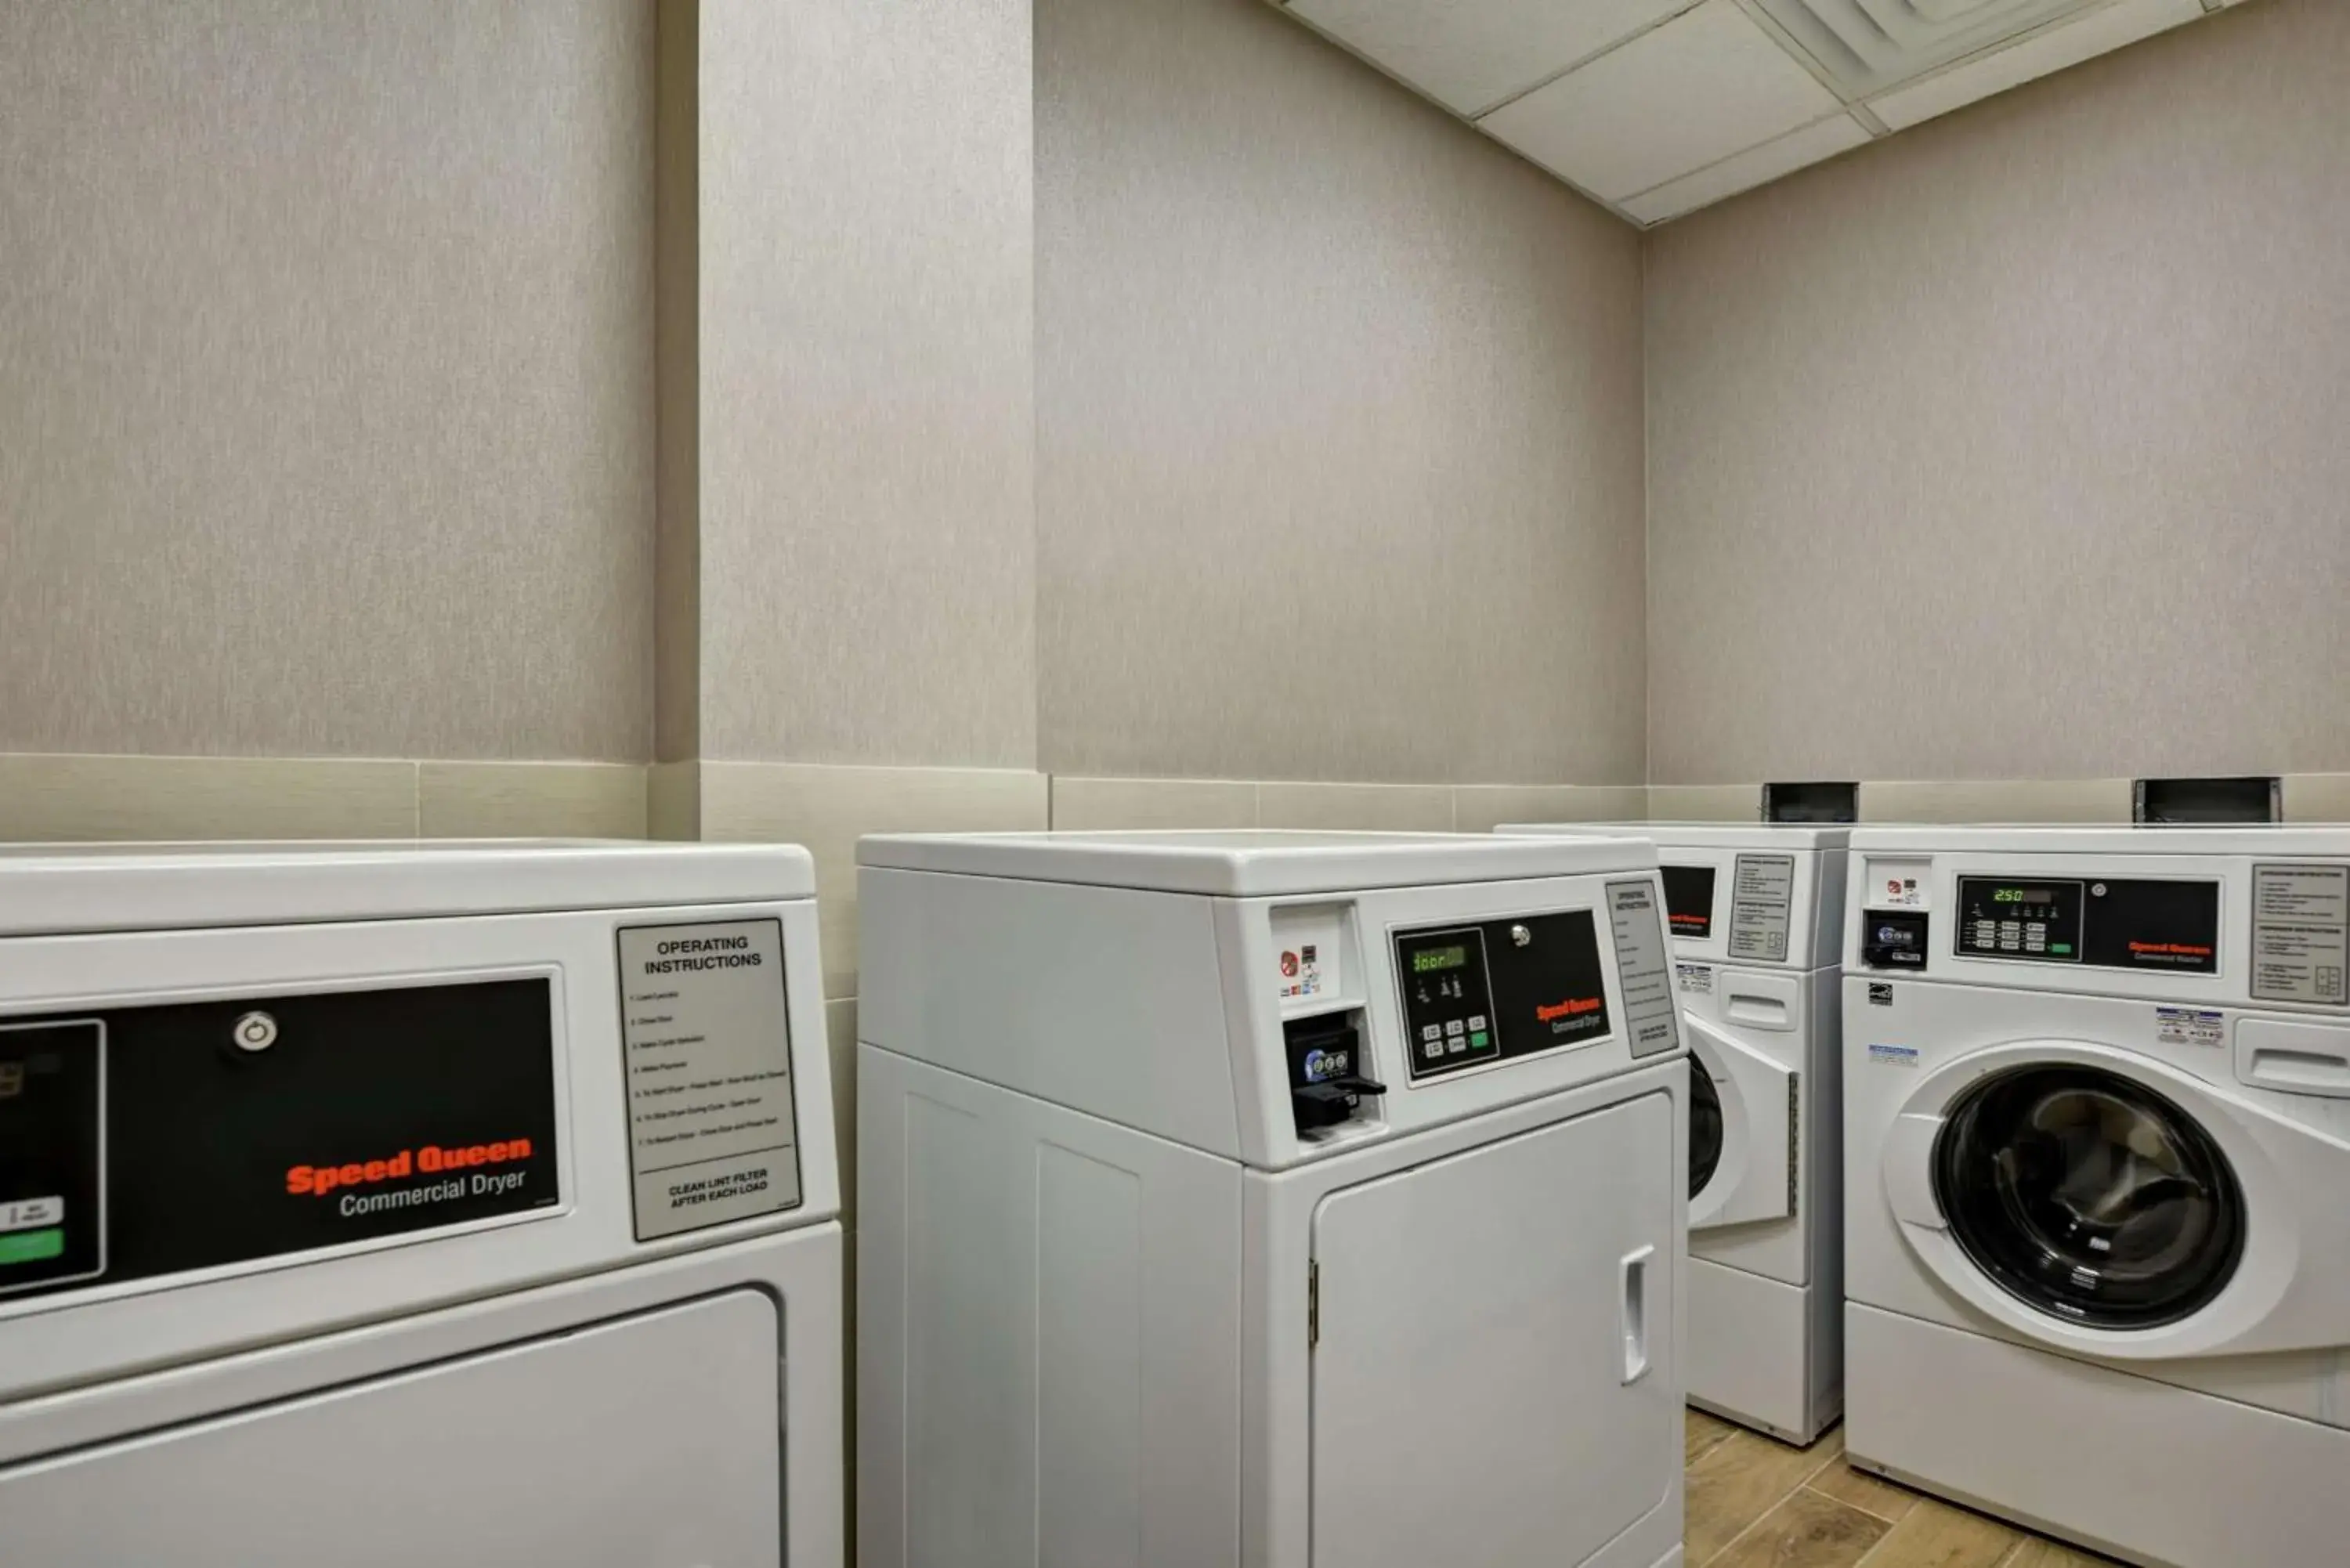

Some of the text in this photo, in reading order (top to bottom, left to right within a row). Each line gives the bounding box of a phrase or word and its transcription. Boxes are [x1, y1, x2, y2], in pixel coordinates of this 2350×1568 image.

[657, 936, 748, 955] OPERATING
[645, 953, 762, 974] INSTRUCTIONS
[287, 1138, 532, 1196] Speed Queen
[340, 1170, 526, 1216] Commercial Dryer
[669, 1181, 706, 1197] CLEAN
[671, 1180, 768, 1209] AFTER EACH LOAD
